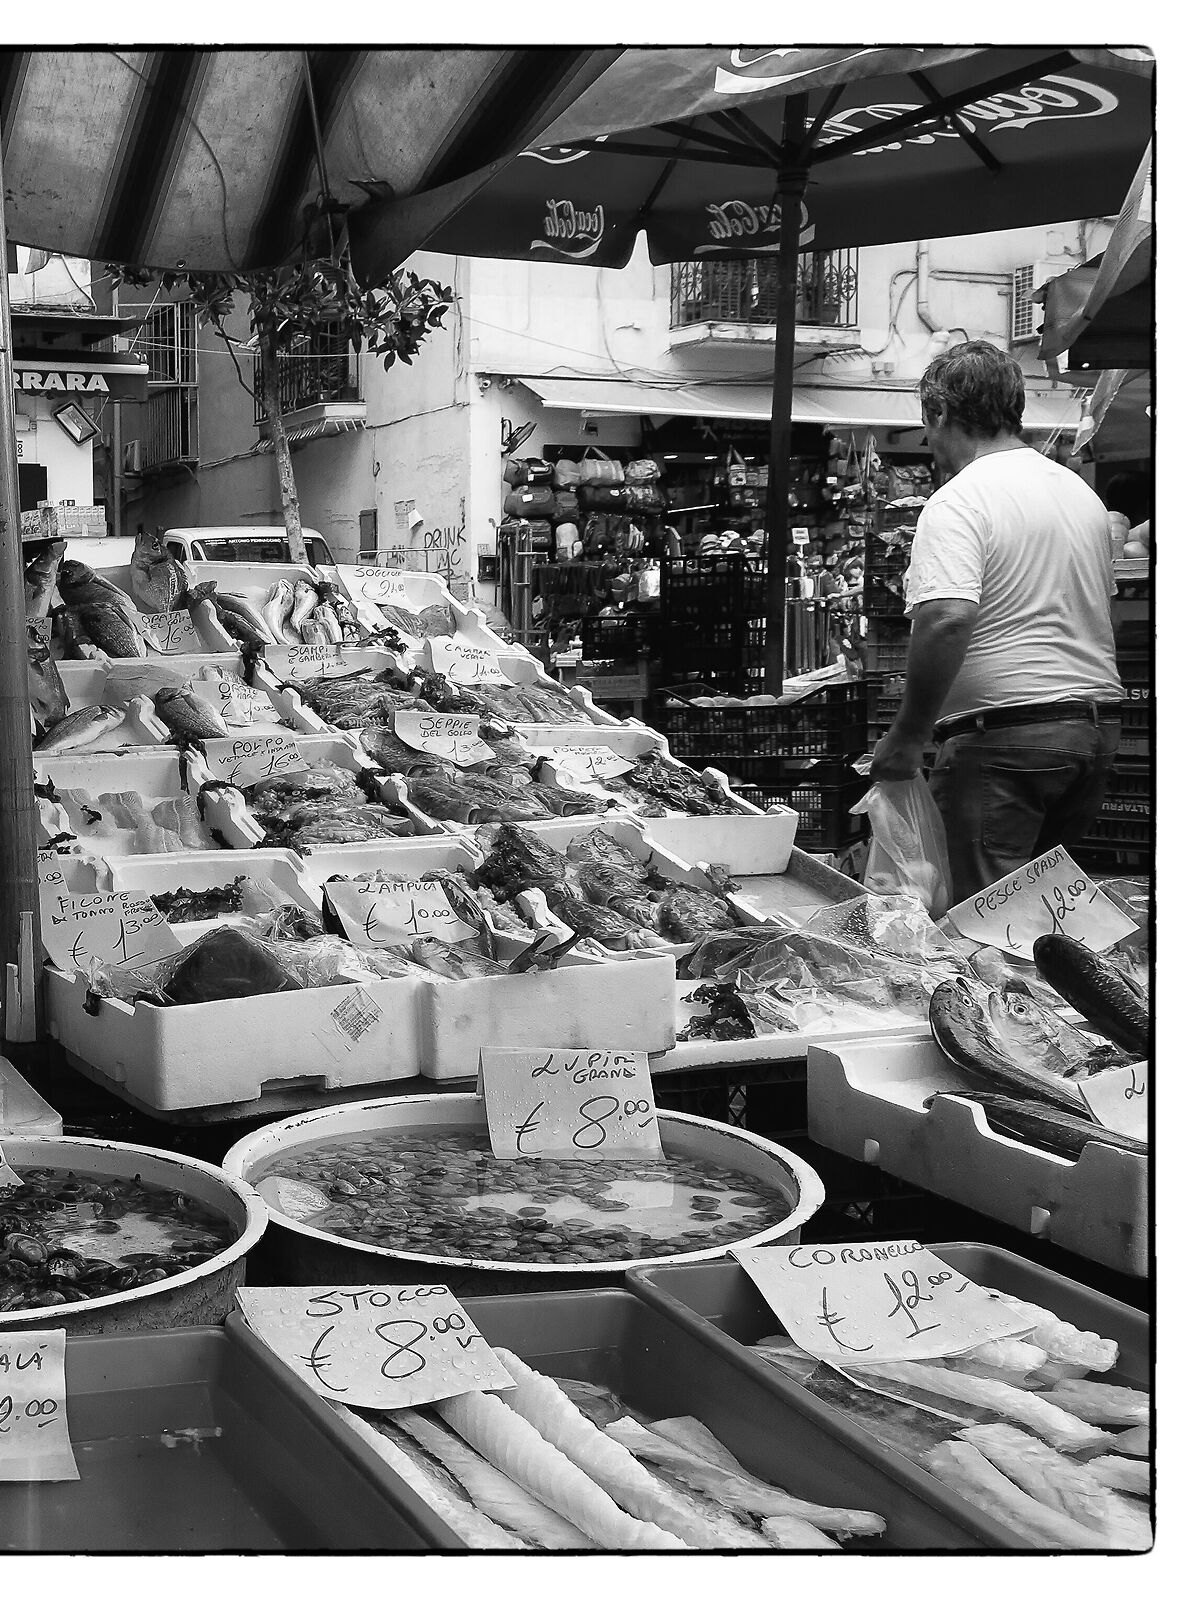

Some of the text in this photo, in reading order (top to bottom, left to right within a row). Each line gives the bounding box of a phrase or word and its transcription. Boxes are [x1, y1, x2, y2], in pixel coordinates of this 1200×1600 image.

[72, 907, 114, 921] TONNO
[973, 850, 1066, 919] PESCE SPADA
[362, 899, 452, 944] € 10.00
[514, 1095, 652, 1155] € 8.00
[305, 1286, 449, 1318] STOCCO
[816, 1269, 955, 1352] € 12.00
[299, 1312, 467, 1392] € 8.00
